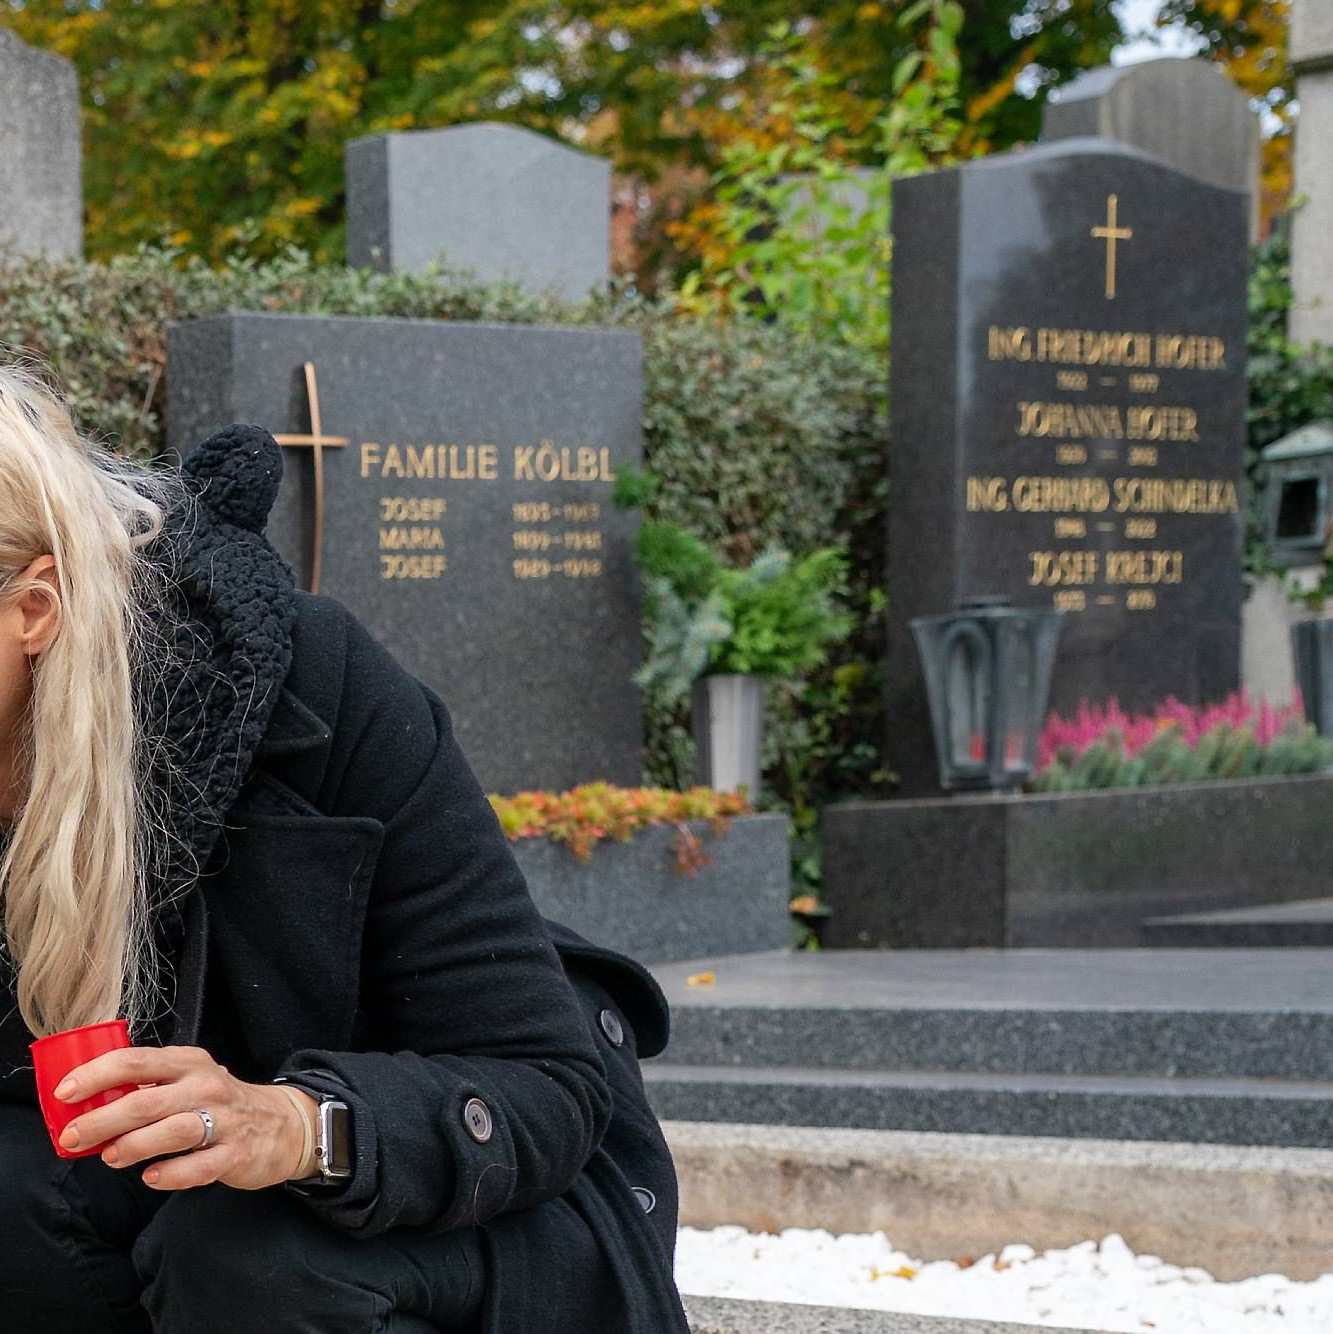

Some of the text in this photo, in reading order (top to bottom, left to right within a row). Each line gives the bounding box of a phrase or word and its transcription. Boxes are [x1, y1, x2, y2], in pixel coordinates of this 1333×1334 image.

[359, 439, 617, 482] FAMILIE KÖLBL
[378, 497, 448, 522] JOSEF
[378, 527, 445, 551] MARIA
[378, 555, 448, 580] JOSEF
[1028, 550, 1098, 587] JOSEF
